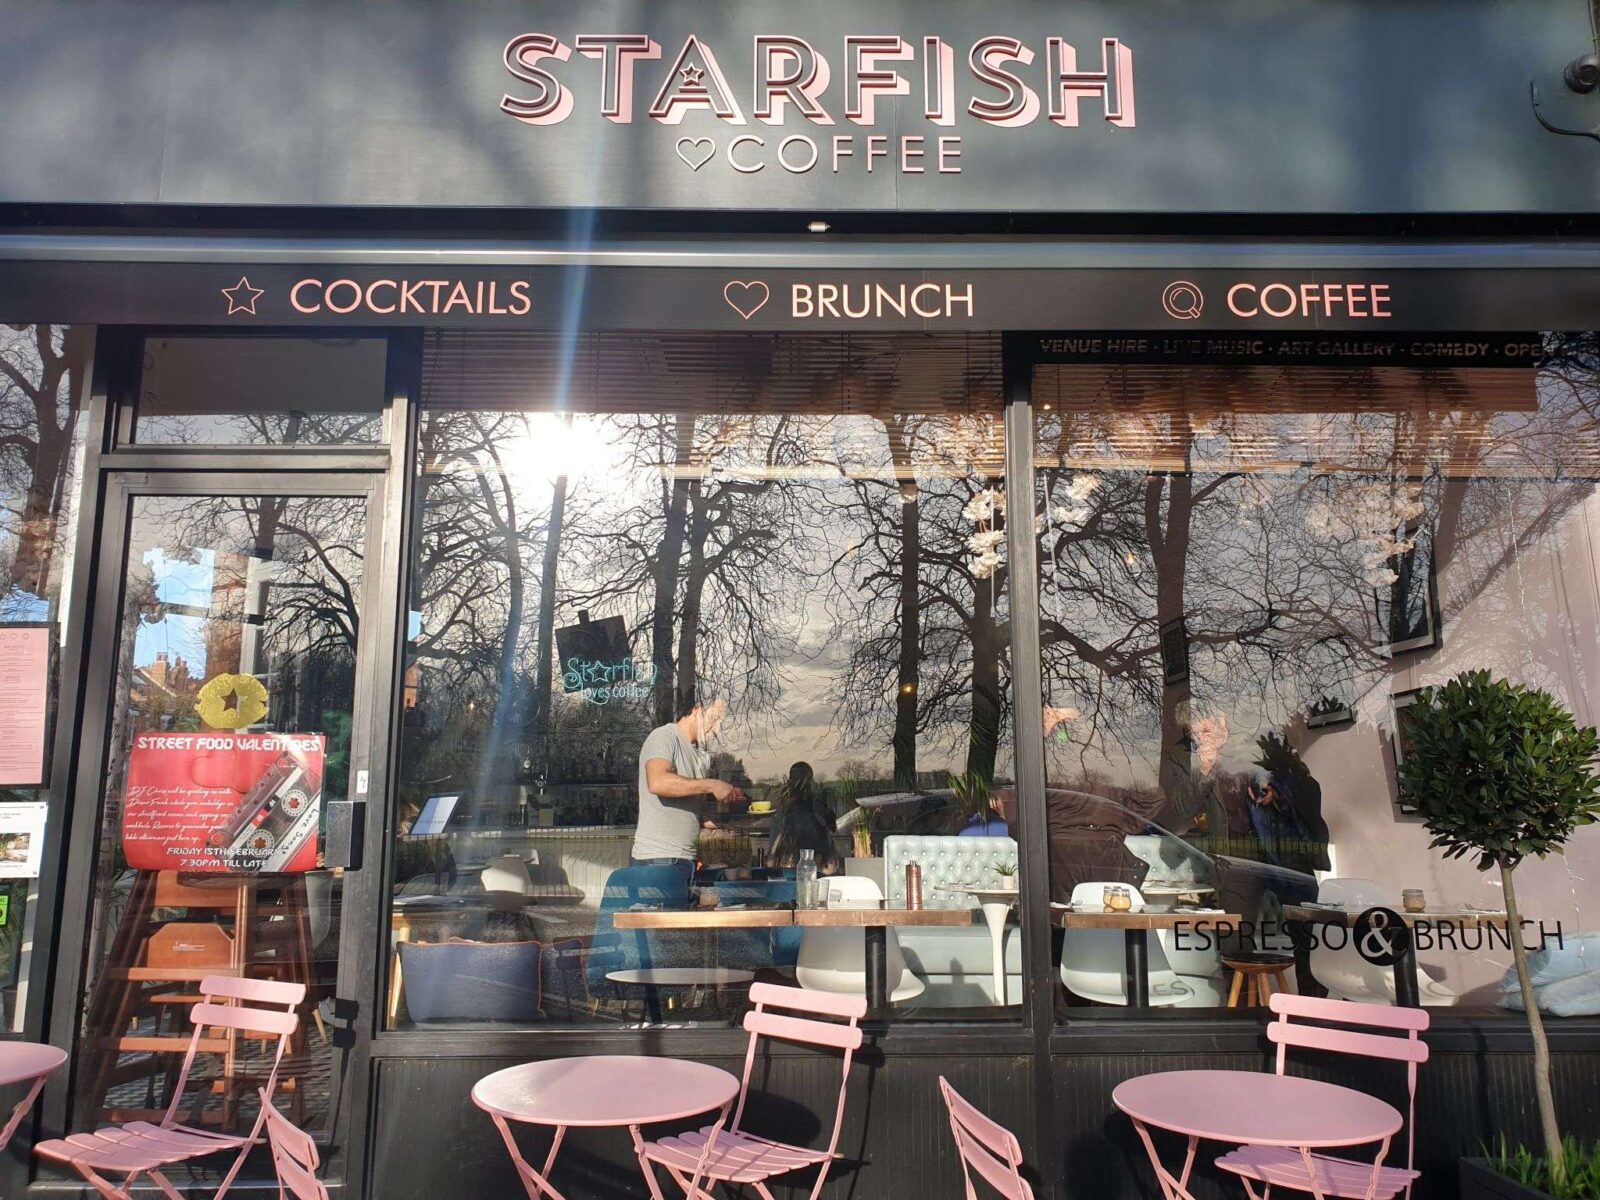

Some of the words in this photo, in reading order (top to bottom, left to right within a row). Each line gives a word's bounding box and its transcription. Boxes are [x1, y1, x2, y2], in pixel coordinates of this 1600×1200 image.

[500, 32, 1137, 129] STARFISH
[727, 133, 962, 174] COFFEE
[290, 278, 532, 316] COCKTAILS
[791, 283, 976, 319] BRUNCH
[1226, 282, 1393, 319] COFFEE
[1040, 338, 1101, 353] VENUE
[1107, 338, 1148, 353] HIRE
[1277, 340, 1312, 356] ART
[1318, 341, 1396, 357] GALLERY
[1410, 342, 1489, 358] COMEDY
[1504, 343, 1553, 358] OPE
[137, 736, 193, 751] STREET
[196, 738, 233, 751] FOOD
[236, 739, 320, 752] VALENTNES
[166, 847, 202, 856] FRIDAY
[180, 858, 220, 868] 730PM
[222, 859, 241, 868] TILL
[243, 860, 267, 868] LATE
[1174, 920, 1348, 951] ESPRESSO
[1357, 908, 1406, 961] &
[1413, 919, 1564, 952] BRUNCH
